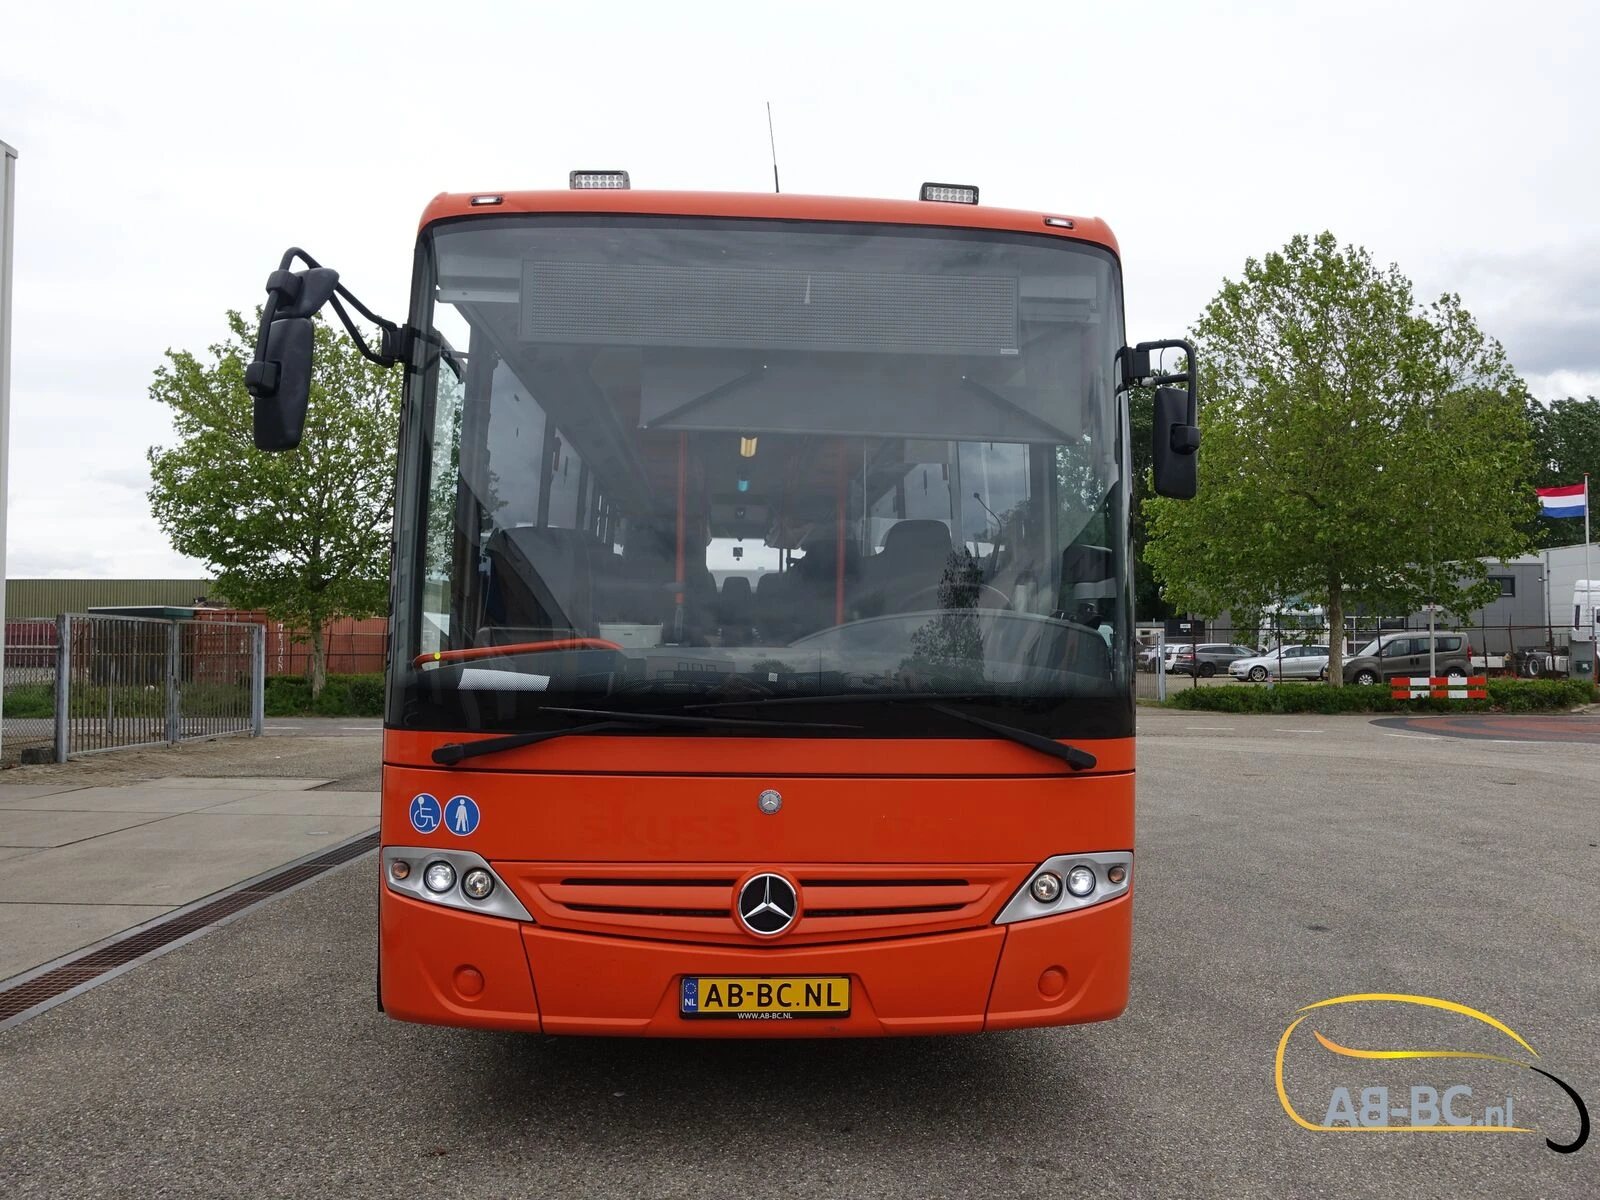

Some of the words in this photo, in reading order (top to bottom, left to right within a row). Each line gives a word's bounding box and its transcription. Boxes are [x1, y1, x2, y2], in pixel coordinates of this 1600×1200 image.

[704, 983, 841, 1007] AB-BC.NL
[684, 998, 697, 1007] NL
[737, 1012, 793, 1020] WWW.AB-BC.NL
